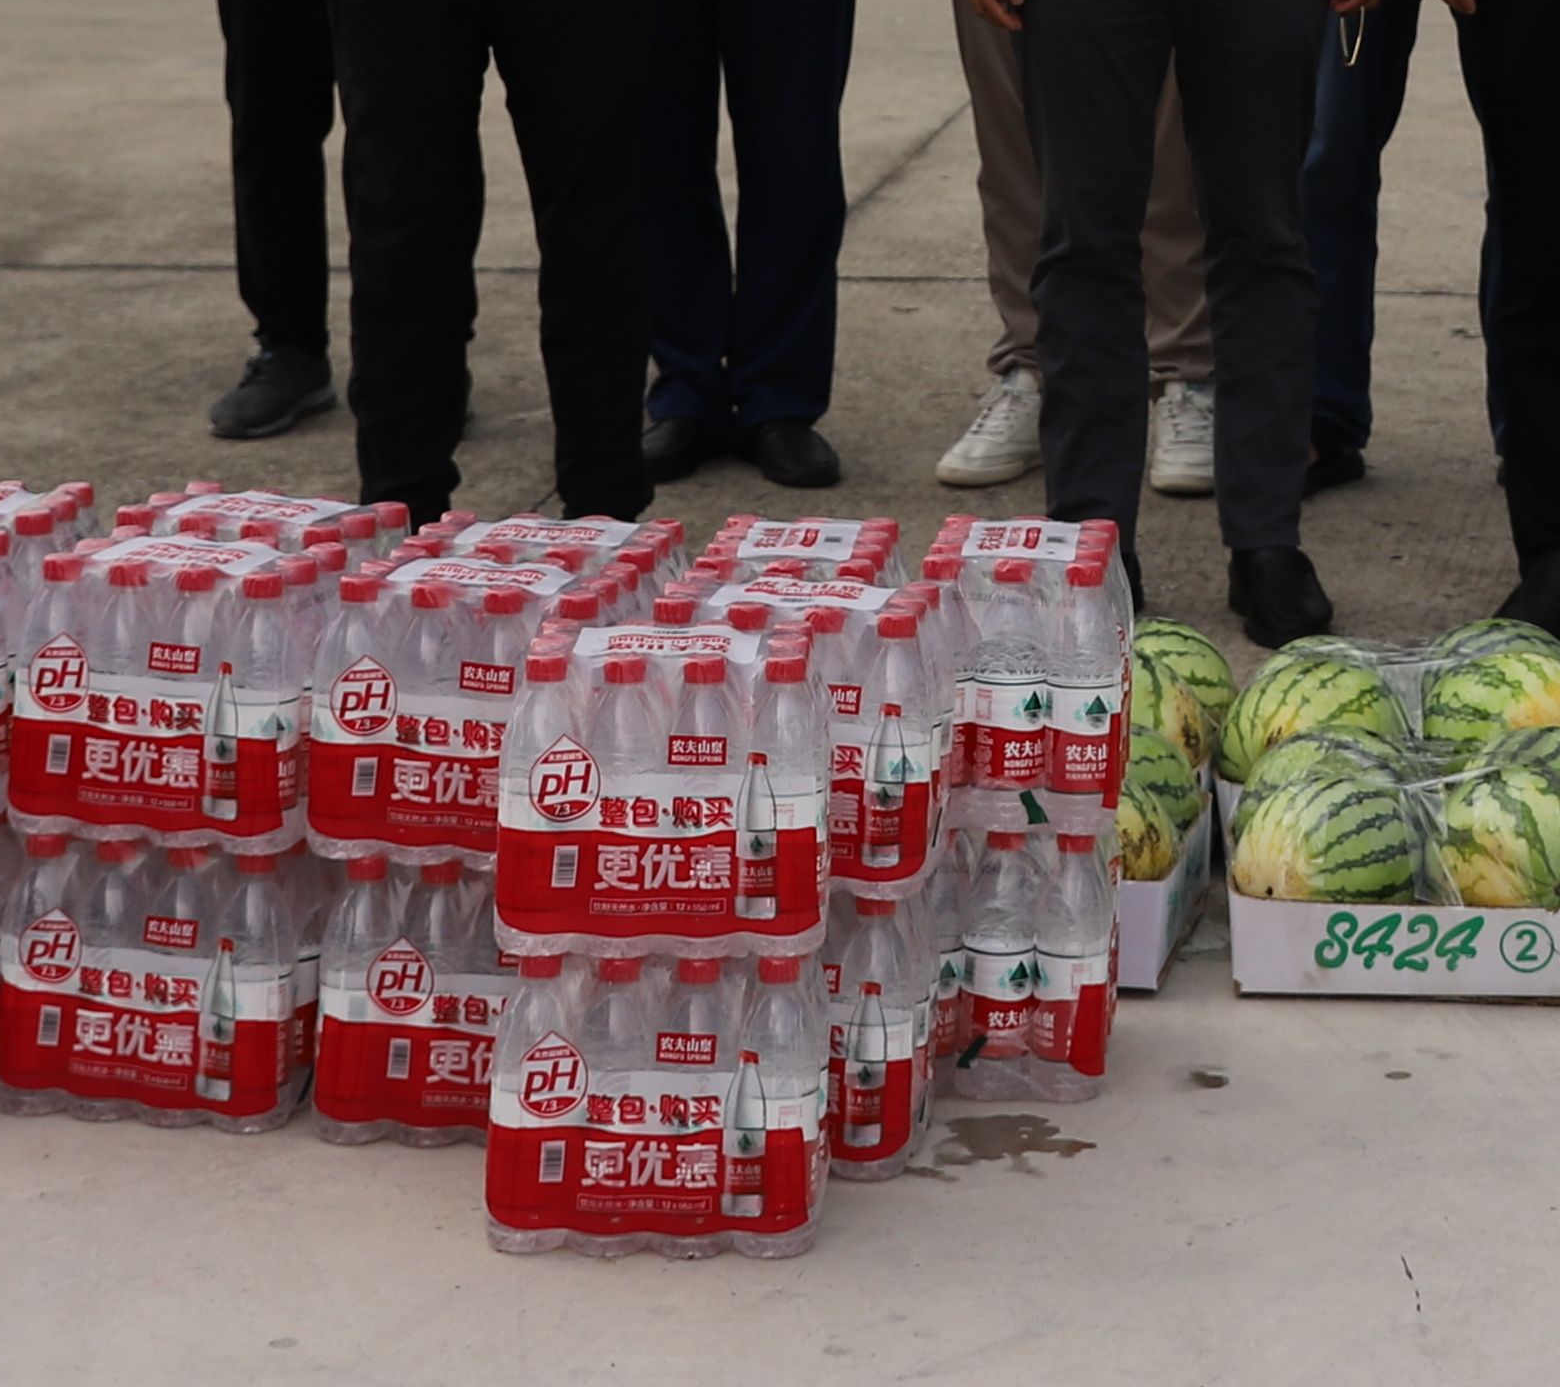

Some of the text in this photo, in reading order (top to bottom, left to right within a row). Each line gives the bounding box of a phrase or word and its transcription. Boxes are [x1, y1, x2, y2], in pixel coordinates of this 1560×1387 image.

[35, 660, 84, 694] pH
[339, 682, 390, 718] pH
[81, 737, 200, 789] 更优惠
[671, 738, 723, 754] 农夫山泉
[537, 763, 591, 803] pH
[594, 843, 732, 891] 更优惠
[27, 933, 76, 964] pH
[1314, 911, 1487, 972] 8424
[375, 964, 424, 996] pH
[73, 1009, 194, 1066] 更优惠
[660, 1037, 712, 1053] 农夫山泉
[524, 1059, 579, 1100] pH
[581, 1140, 718, 1188] 更优惠
